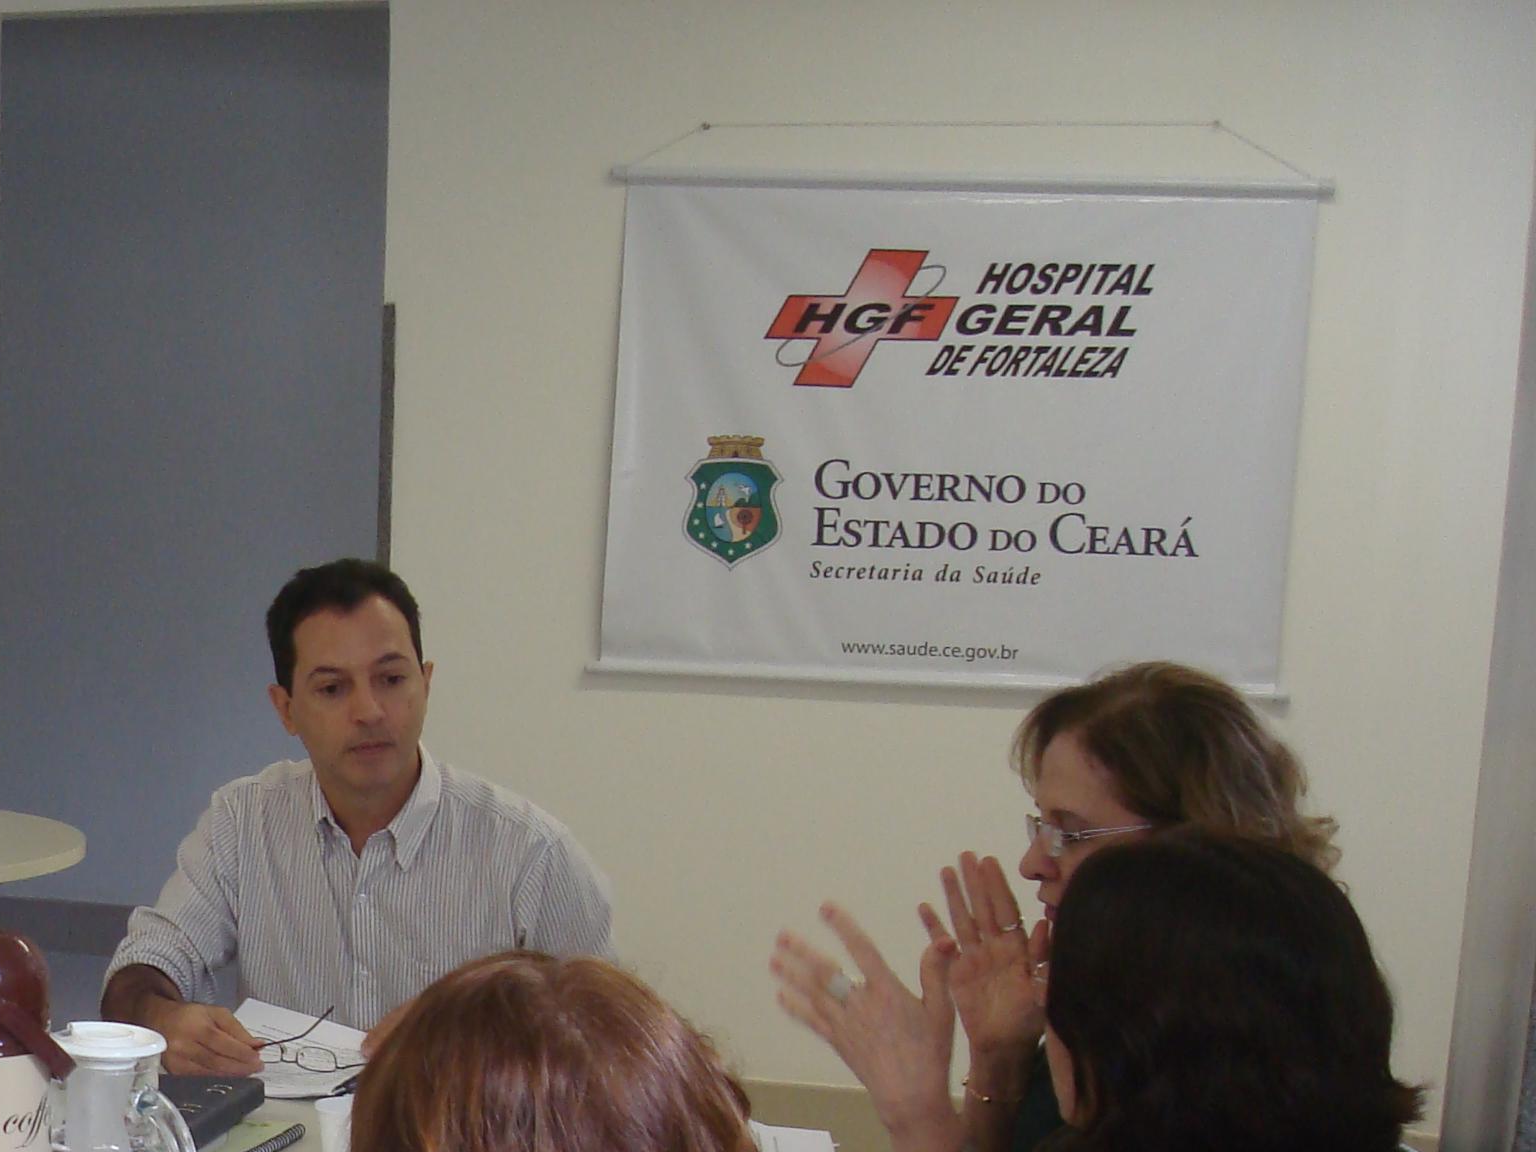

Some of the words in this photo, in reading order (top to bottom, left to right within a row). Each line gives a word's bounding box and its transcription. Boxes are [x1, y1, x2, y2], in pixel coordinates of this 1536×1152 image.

[975, 262, 1156, 296] HOSPITAL
[793, 302, 936, 335] HGF
[955, 303, 1138, 338] GERAL
[925, 344, 968, 376] DE
[967, 345, 1130, 379] FORTALEZA
[813, 458, 1027, 505] GOVERNO
[1036, 481, 1087, 505] DO
[810, 506, 978, 552] ESTADO
[988, 528, 1038, 553] DO
[1048, 512, 1200, 558] CEARÁ
[809, 560, 924, 583] Secretaria
[934, 562, 962, 584] da
[972, 565, 1042, 586] Saúde
[840, 640, 1020, 663] www.saude.ce.gov.br
